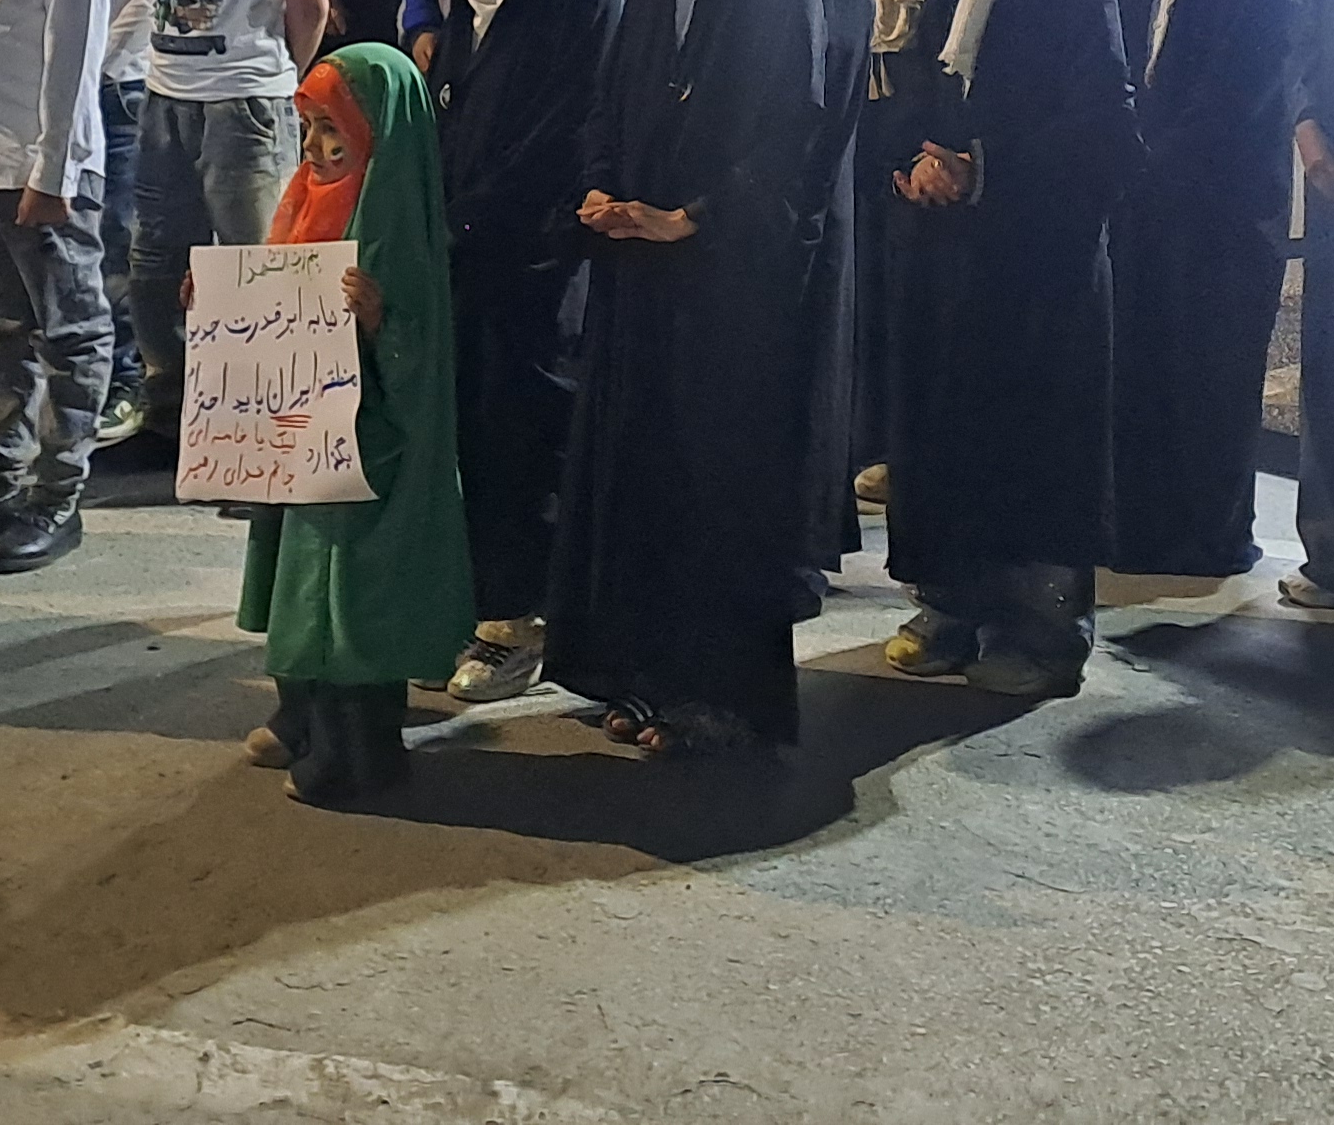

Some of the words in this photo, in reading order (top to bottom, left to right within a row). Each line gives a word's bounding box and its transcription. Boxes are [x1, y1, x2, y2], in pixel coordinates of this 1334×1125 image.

[319, 295, 352, 333] دنیا
[189, 318, 221, 350] جدید
[232, 362, 264, 415] باید
[267, 351, 317, 414] ایران
[253, 421, 266, 452] یا
